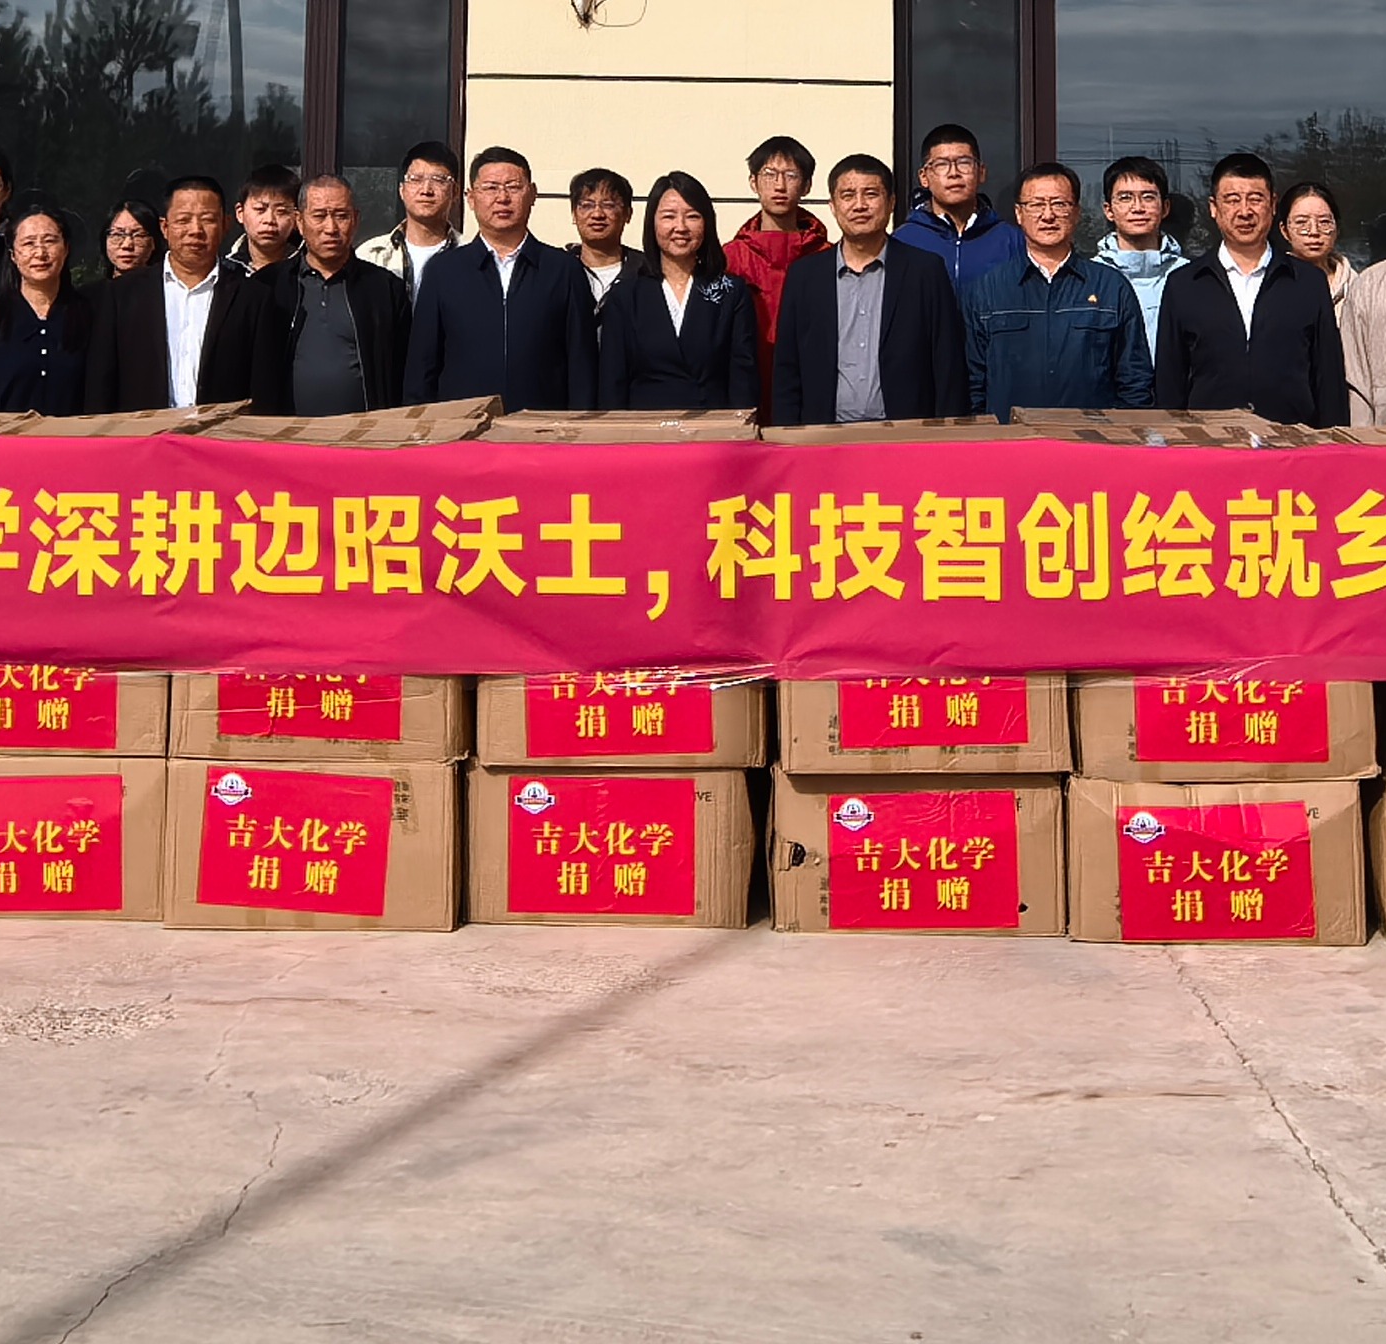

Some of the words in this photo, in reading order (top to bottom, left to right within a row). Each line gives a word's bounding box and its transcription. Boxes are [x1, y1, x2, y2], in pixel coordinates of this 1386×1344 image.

[266, 688, 353, 720] 捐赠
[575, 704, 665, 737] 捐赠
[889, 694, 979, 728] 捐赠
[1186, 712, 1278, 744] 捐赠
[224, 815, 368, 855] 吉大化学
[532, 823, 674, 856] 吉大化学
[853, 838, 996, 871] 吉大化学
[1144, 850, 1289, 883] 吉大化学
[248, 856, 339, 894] 捐赠
[557, 863, 647, 895] 捐赠
[880, 878, 970, 910] 捐赠
[1172, 889, 1264, 922] 捐赠
